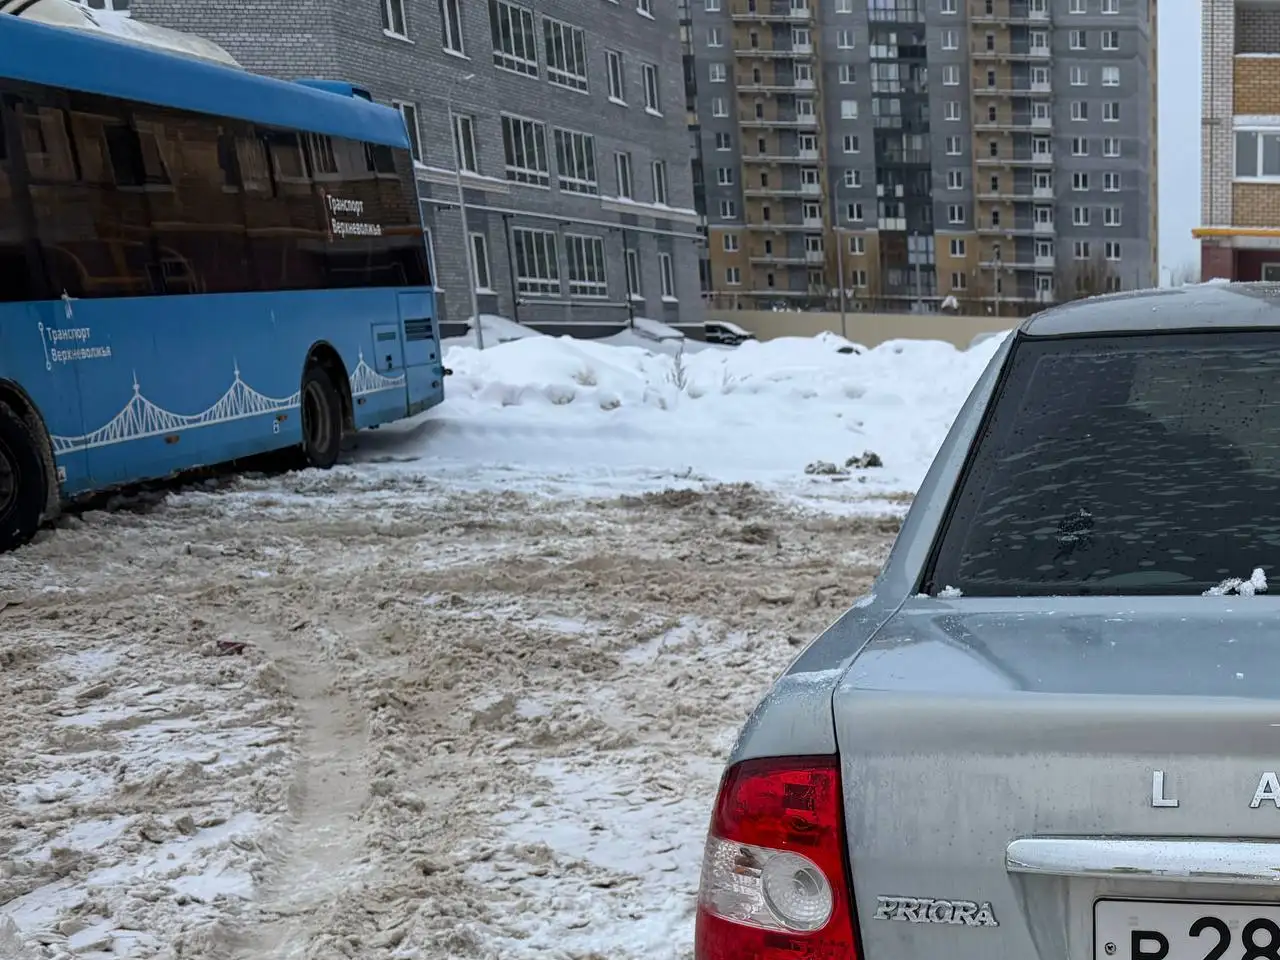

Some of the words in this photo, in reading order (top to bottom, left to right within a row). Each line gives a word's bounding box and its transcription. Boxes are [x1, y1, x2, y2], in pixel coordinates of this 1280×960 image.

[326, 194, 364, 217] Транспорт
[331, 217, 382, 239] Верхневолжья
[46, 327, 90, 344] Транспорт
[50, 346, 112, 365] Верхневолжья
[873, 895, 1000, 927] PRIORA
